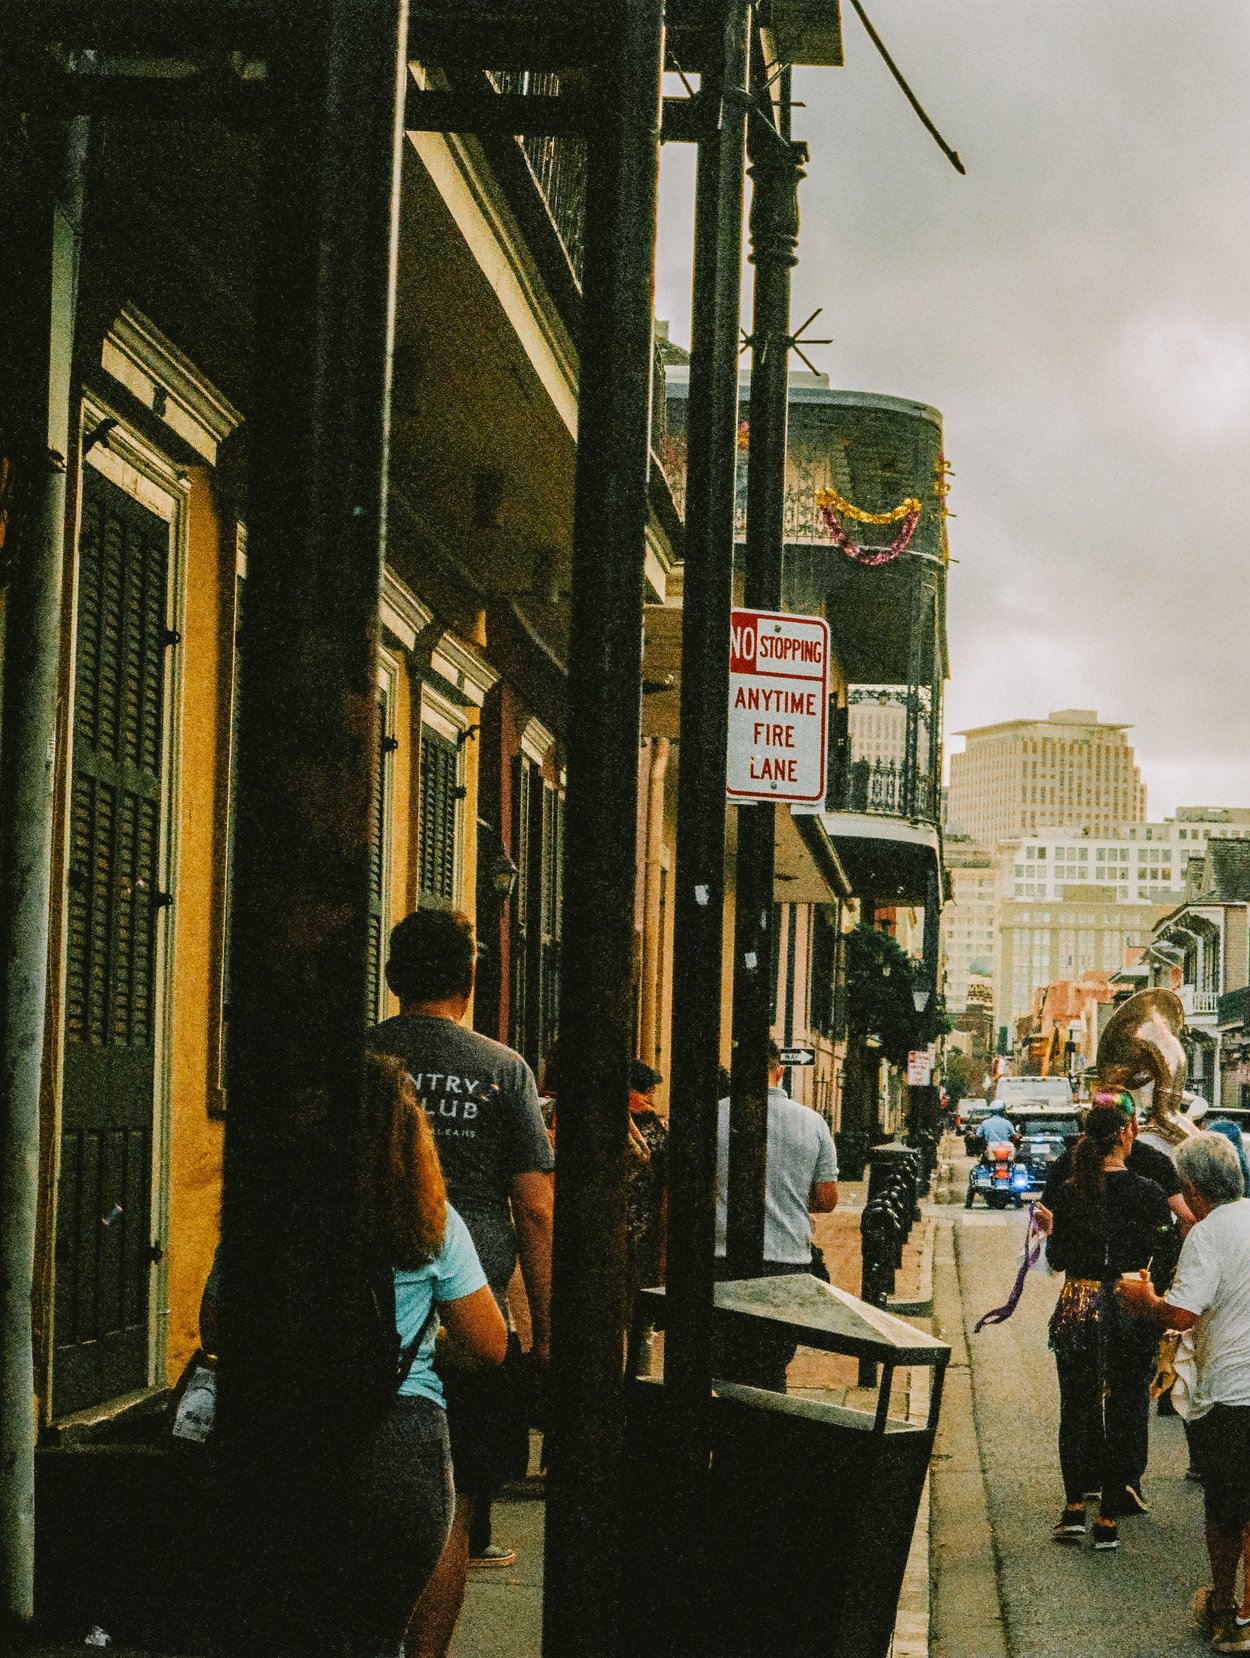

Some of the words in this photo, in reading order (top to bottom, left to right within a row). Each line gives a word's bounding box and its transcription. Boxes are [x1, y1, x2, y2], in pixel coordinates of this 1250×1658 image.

[731, 625, 755, 661] NO
[759, 635, 822, 664] STOPPING
[734, 687, 817, 716] ANYTIME
[753, 723, 796, 748] FIRE
[749, 757, 798, 783] LANE
